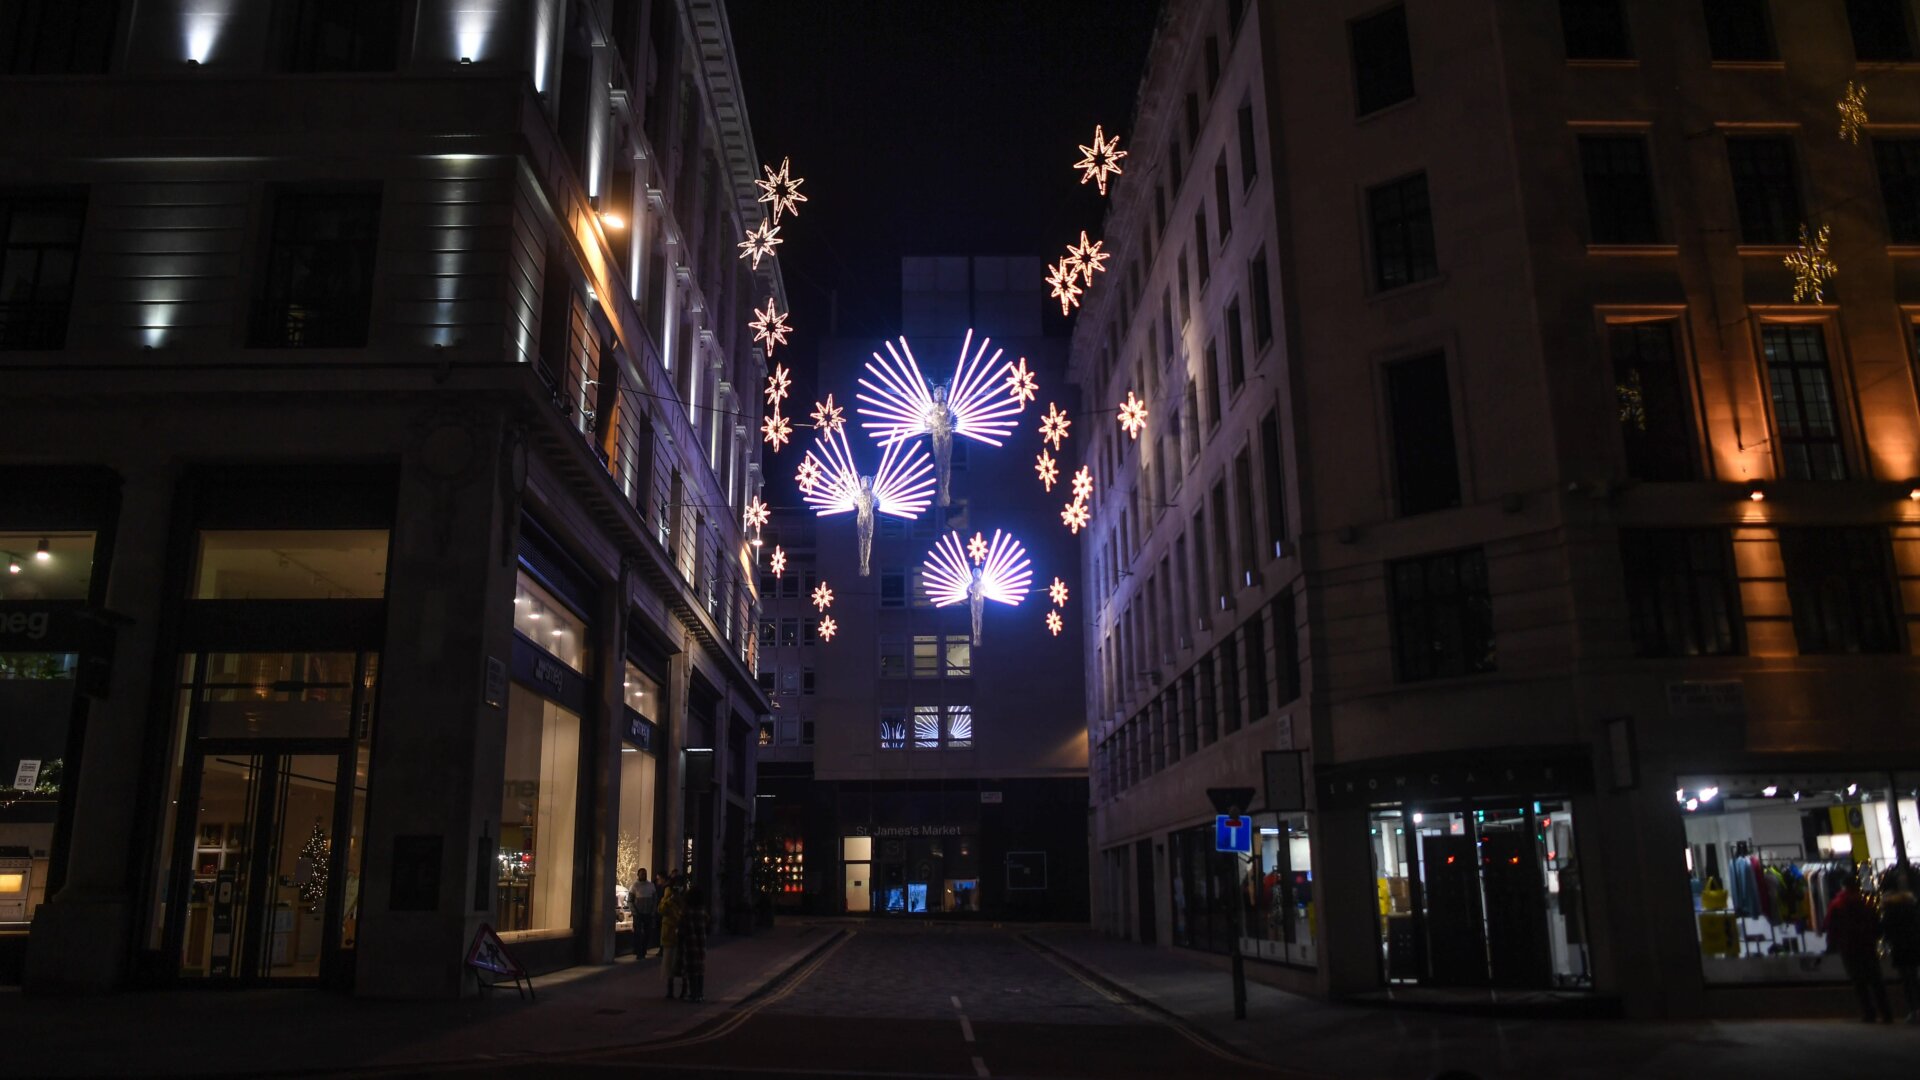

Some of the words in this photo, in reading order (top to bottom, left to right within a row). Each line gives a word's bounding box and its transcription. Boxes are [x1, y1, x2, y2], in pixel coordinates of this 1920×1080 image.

[1329, 767, 1553, 795] SHOWCASE
[856, 825, 871, 836] St.
[874, 825, 919, 836] James's
[922, 825, 961, 836] Market
